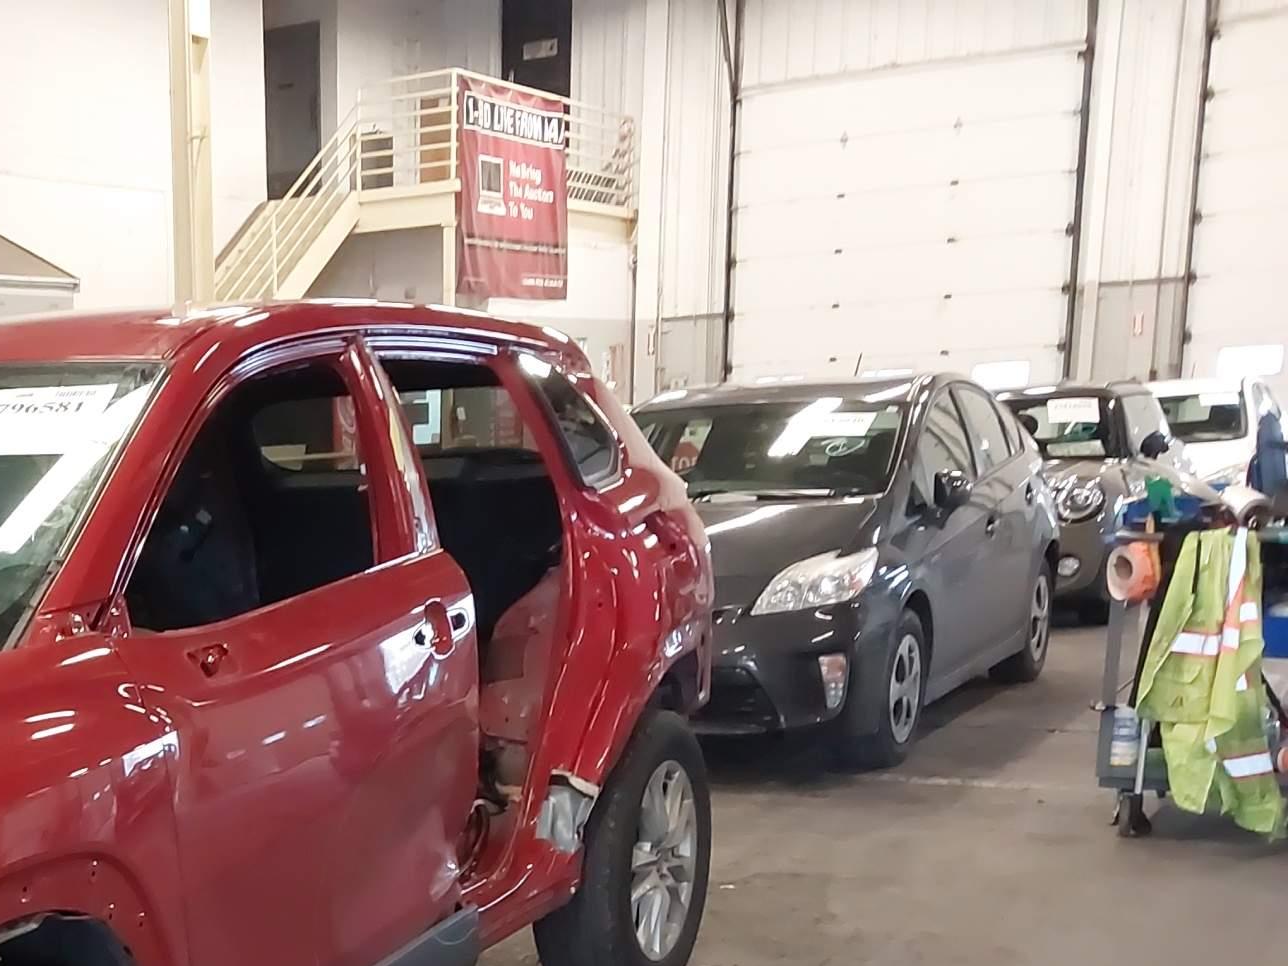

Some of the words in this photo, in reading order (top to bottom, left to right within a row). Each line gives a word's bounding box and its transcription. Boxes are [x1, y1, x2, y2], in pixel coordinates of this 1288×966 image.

[493, 104, 514, 134] LIVE
[515, 109, 543, 142] FROM
[520, 202, 533, 220] You
